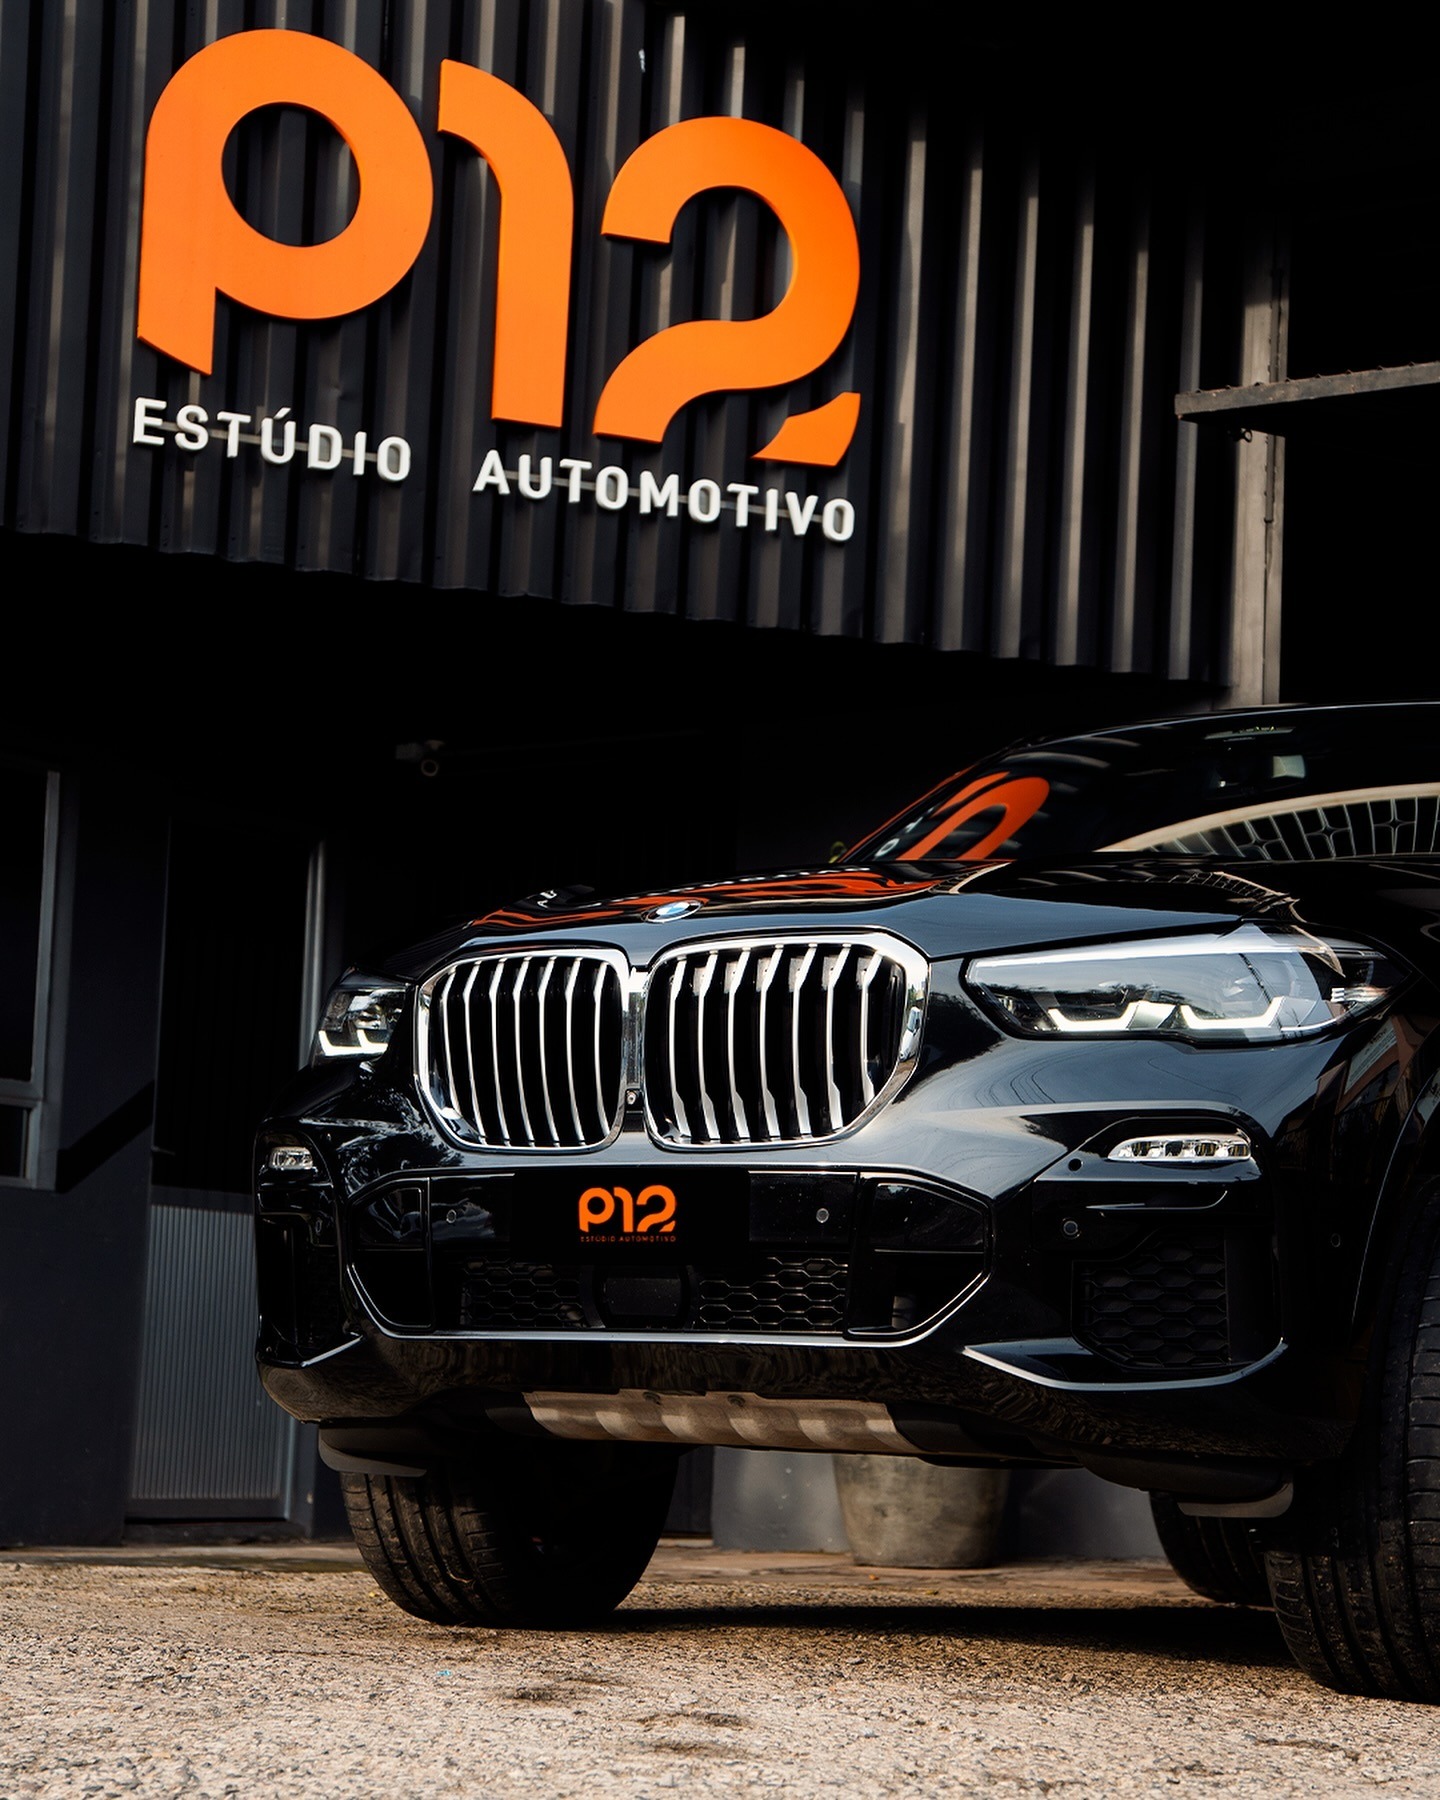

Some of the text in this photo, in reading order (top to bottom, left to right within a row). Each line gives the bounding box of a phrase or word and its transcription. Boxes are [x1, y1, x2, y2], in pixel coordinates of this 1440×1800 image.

[136, 27, 861, 468] P12
[132, 396, 857, 543] ESTÚDIO AUTOMOTIVO
[618, 1235, 677, 1243] AUTOMOTIVO
